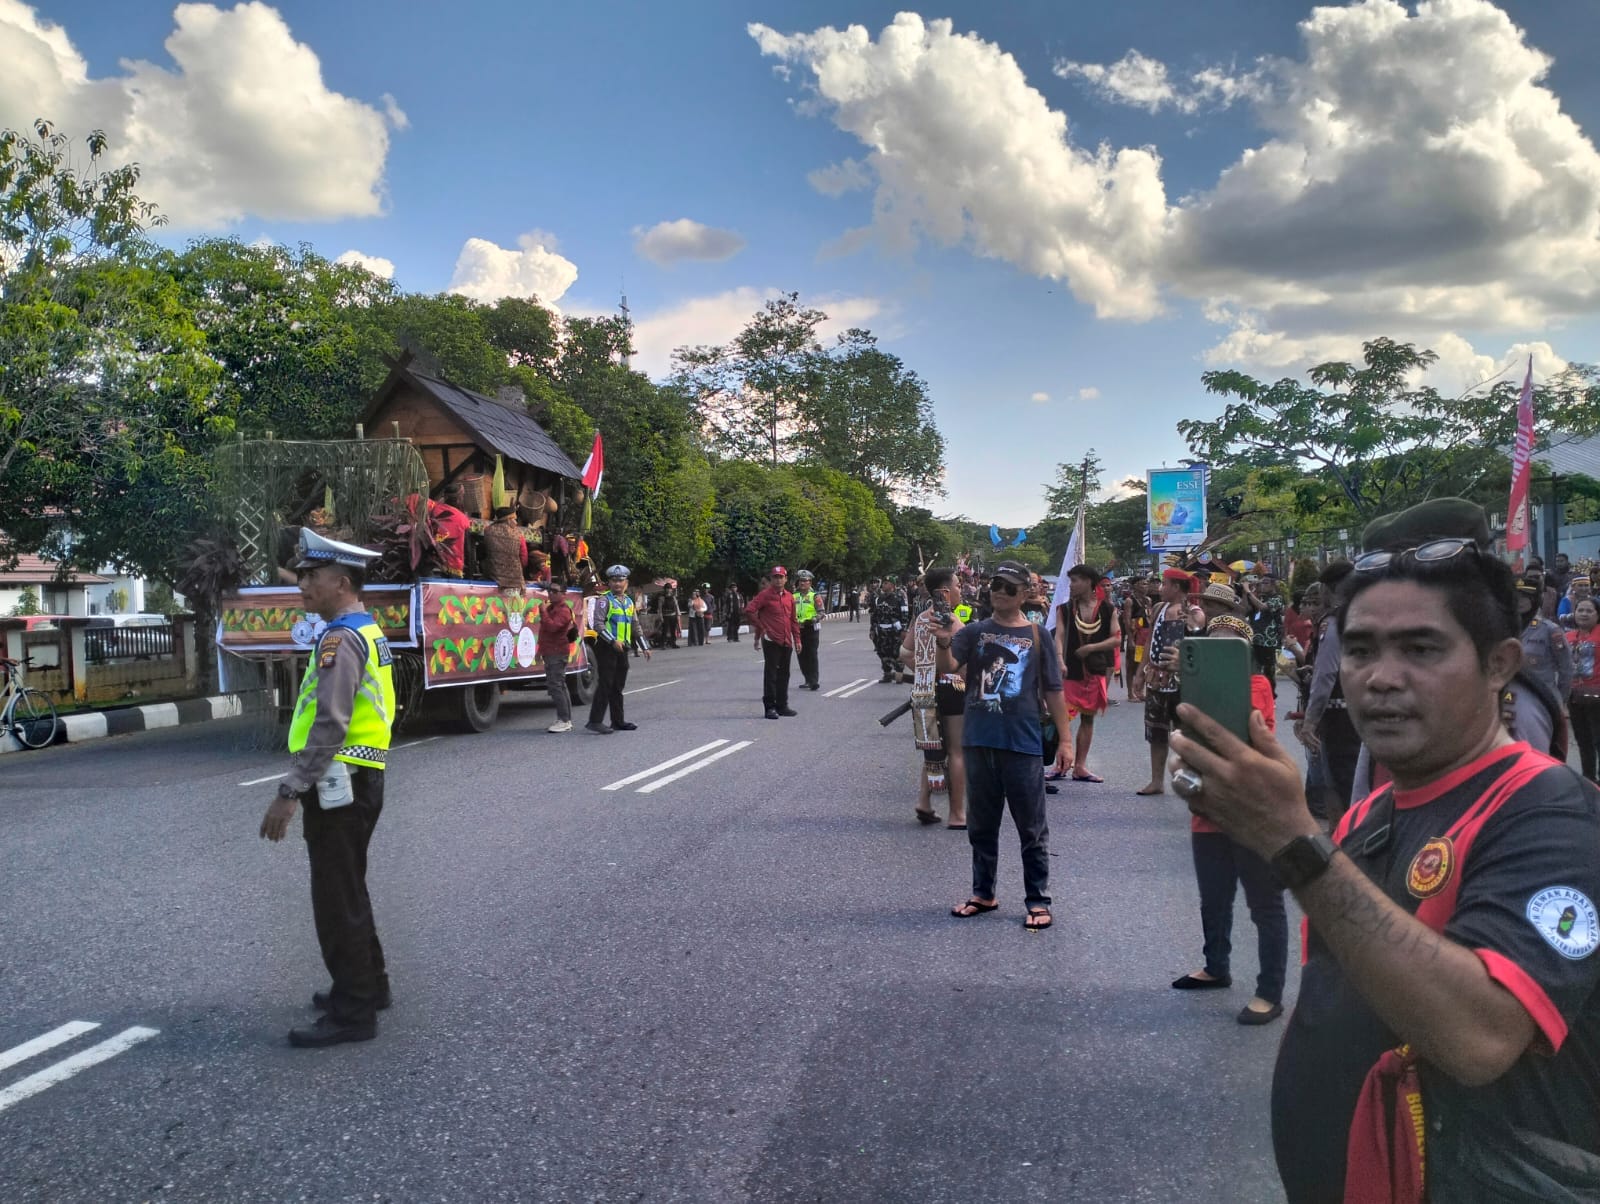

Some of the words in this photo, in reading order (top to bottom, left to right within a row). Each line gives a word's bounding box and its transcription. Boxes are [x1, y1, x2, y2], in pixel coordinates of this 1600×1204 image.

[1176, 481, 1201, 490] ESSE
[1532, 889, 1562, 912] DEWAN
[1564, 891, 1590, 909] ADAT
